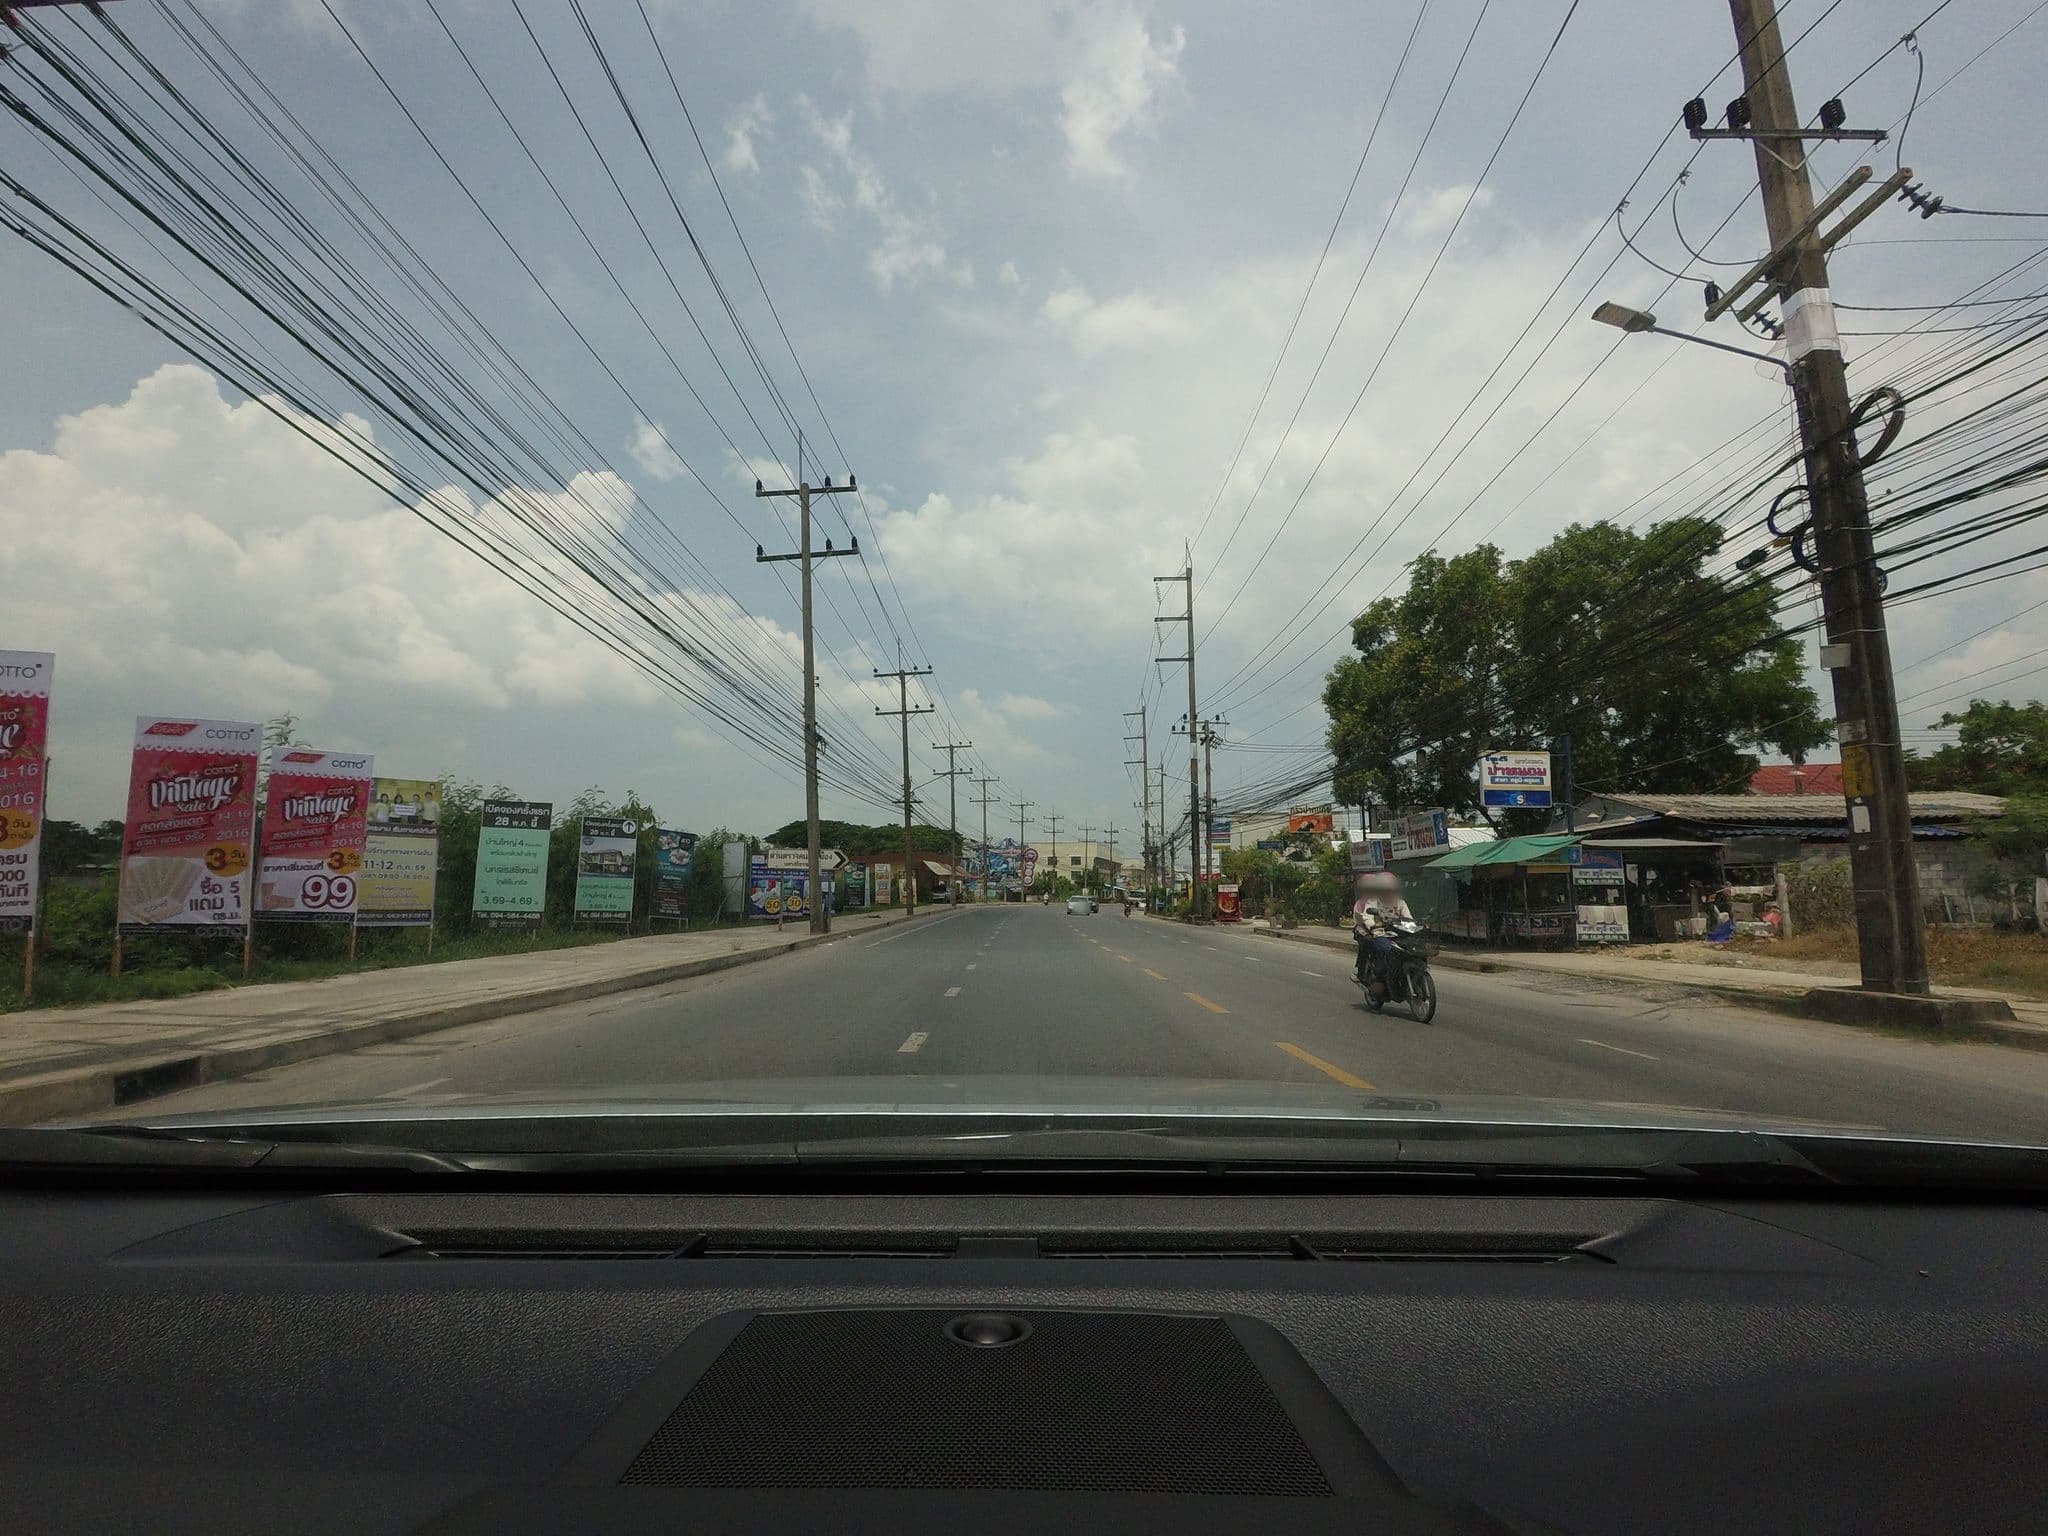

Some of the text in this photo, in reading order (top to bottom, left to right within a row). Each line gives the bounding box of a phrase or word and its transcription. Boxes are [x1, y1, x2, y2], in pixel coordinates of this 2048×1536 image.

[206, 729, 251, 741] COTTO
[331, 760, 364, 769] COTTO
[151, 776, 239, 810] Vintage
[485, 803, 550, 816] เปิดจองครั้งแรก
[495, 816, 509, 826] 28
[531, 816, 539, 827] นี้
[518, 839, 524, 847] 4
[206, 848, 226, 871] 3
[327, 851, 345, 870] 3
[770, 851, 833, 861] ด่านตรวจคนมือง
[364, 860, 393, 870] 11-12
[200, 876, 240, 896] ซื้อ 5
[302, 874, 356, 909] 99
[189, 895, 241, 911] แถม 1
[766, 900, 780, 908] 50
